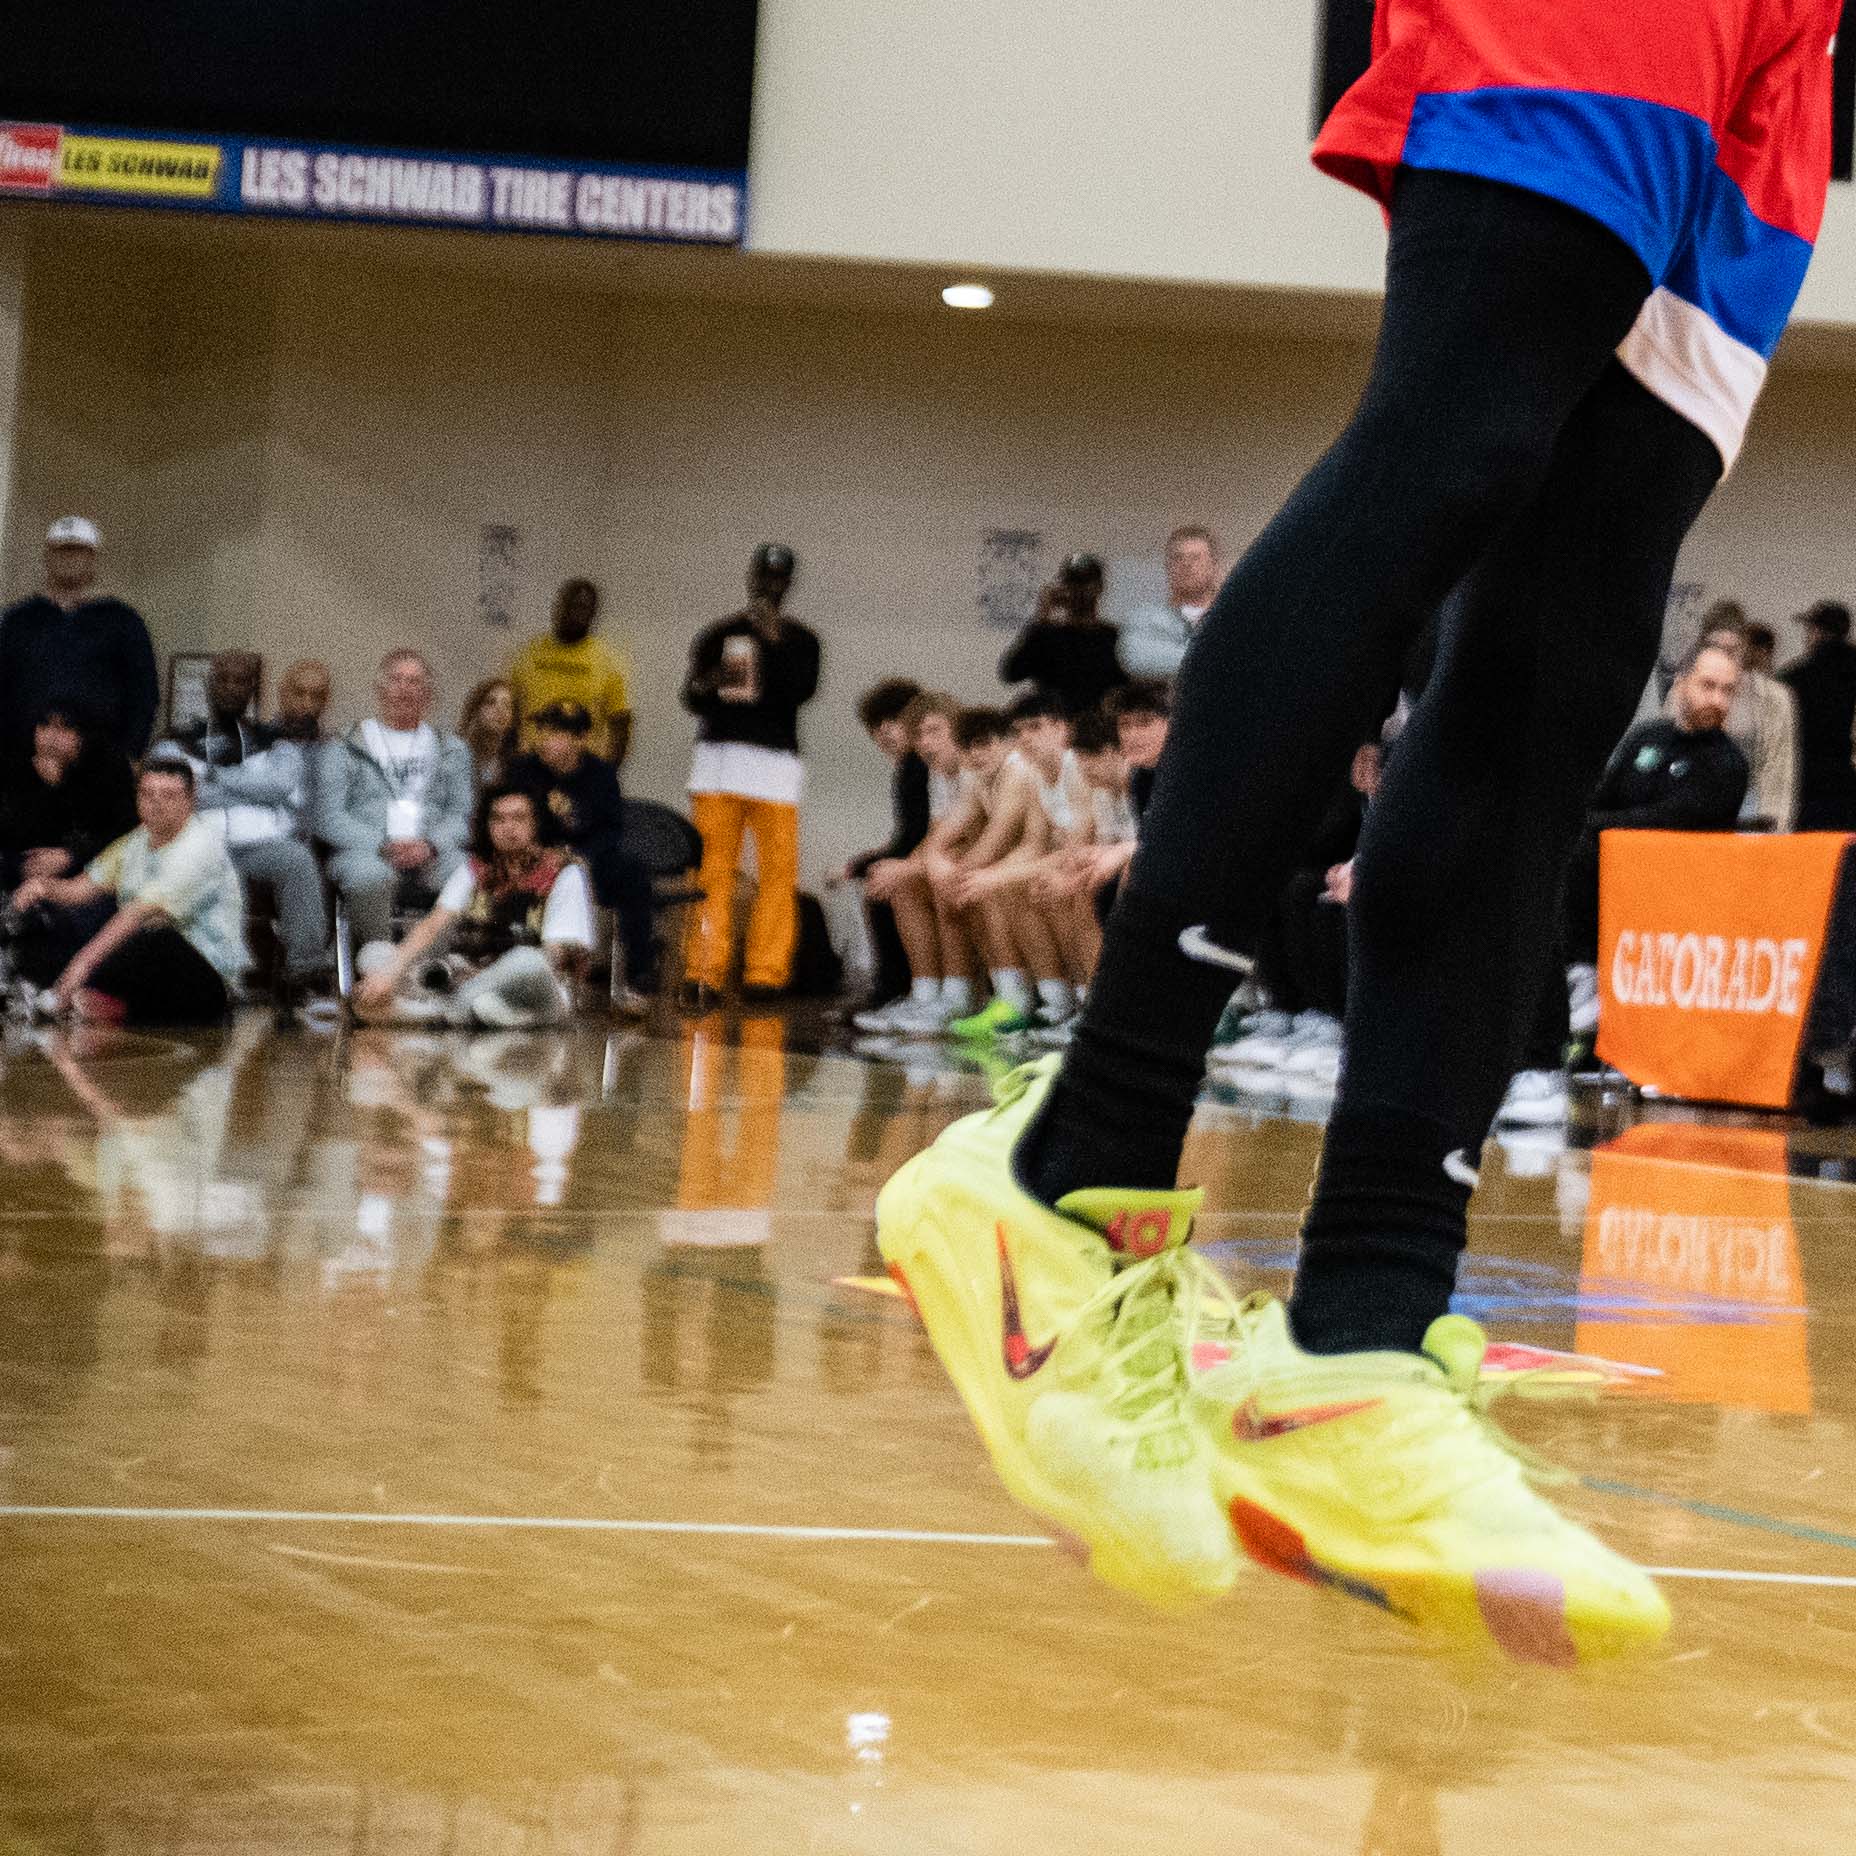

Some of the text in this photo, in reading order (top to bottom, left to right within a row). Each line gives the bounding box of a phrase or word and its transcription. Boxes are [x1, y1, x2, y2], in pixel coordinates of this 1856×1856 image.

[241, 147, 737, 238] LES SCHWAB TIRE CENTERS
[1612, 929, 1808, 1016] GATORADE
